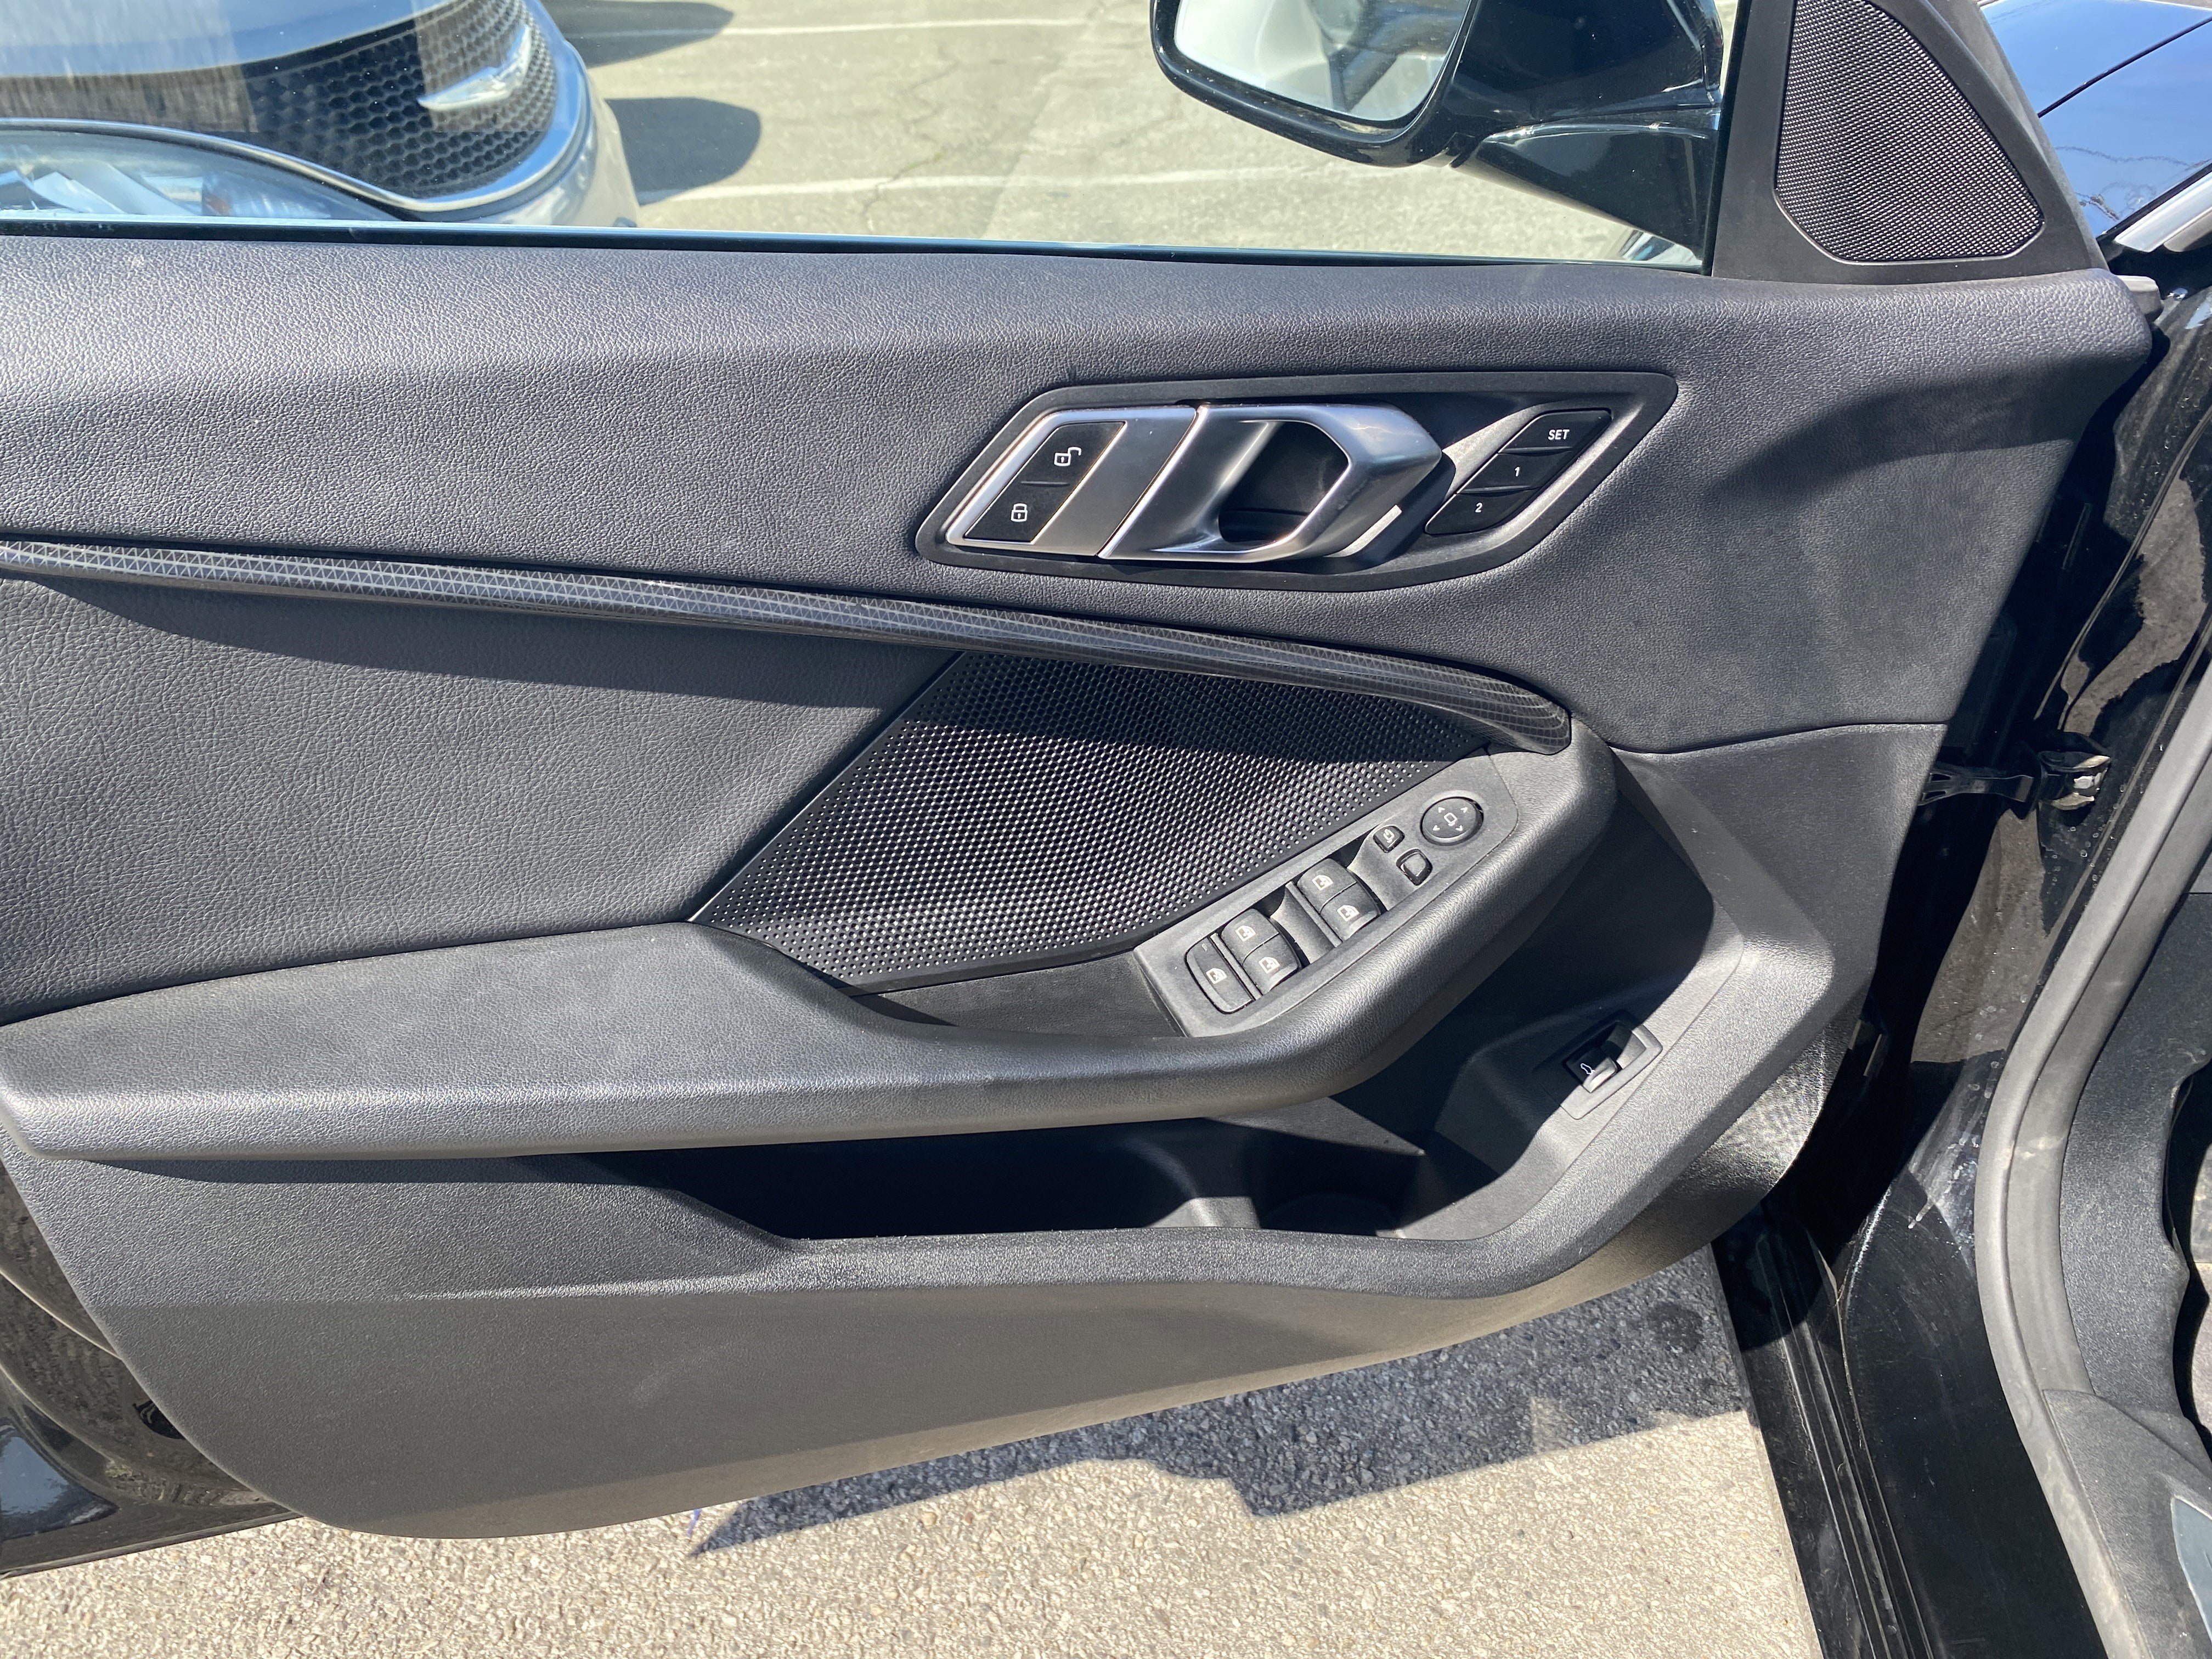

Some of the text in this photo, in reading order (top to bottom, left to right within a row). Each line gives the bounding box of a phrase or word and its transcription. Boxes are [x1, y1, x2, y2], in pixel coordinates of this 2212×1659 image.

[1548, 429, 1570, 441] SET
[1514, 466, 1520, 477] 1
[1475, 502, 1483, 513] 2
